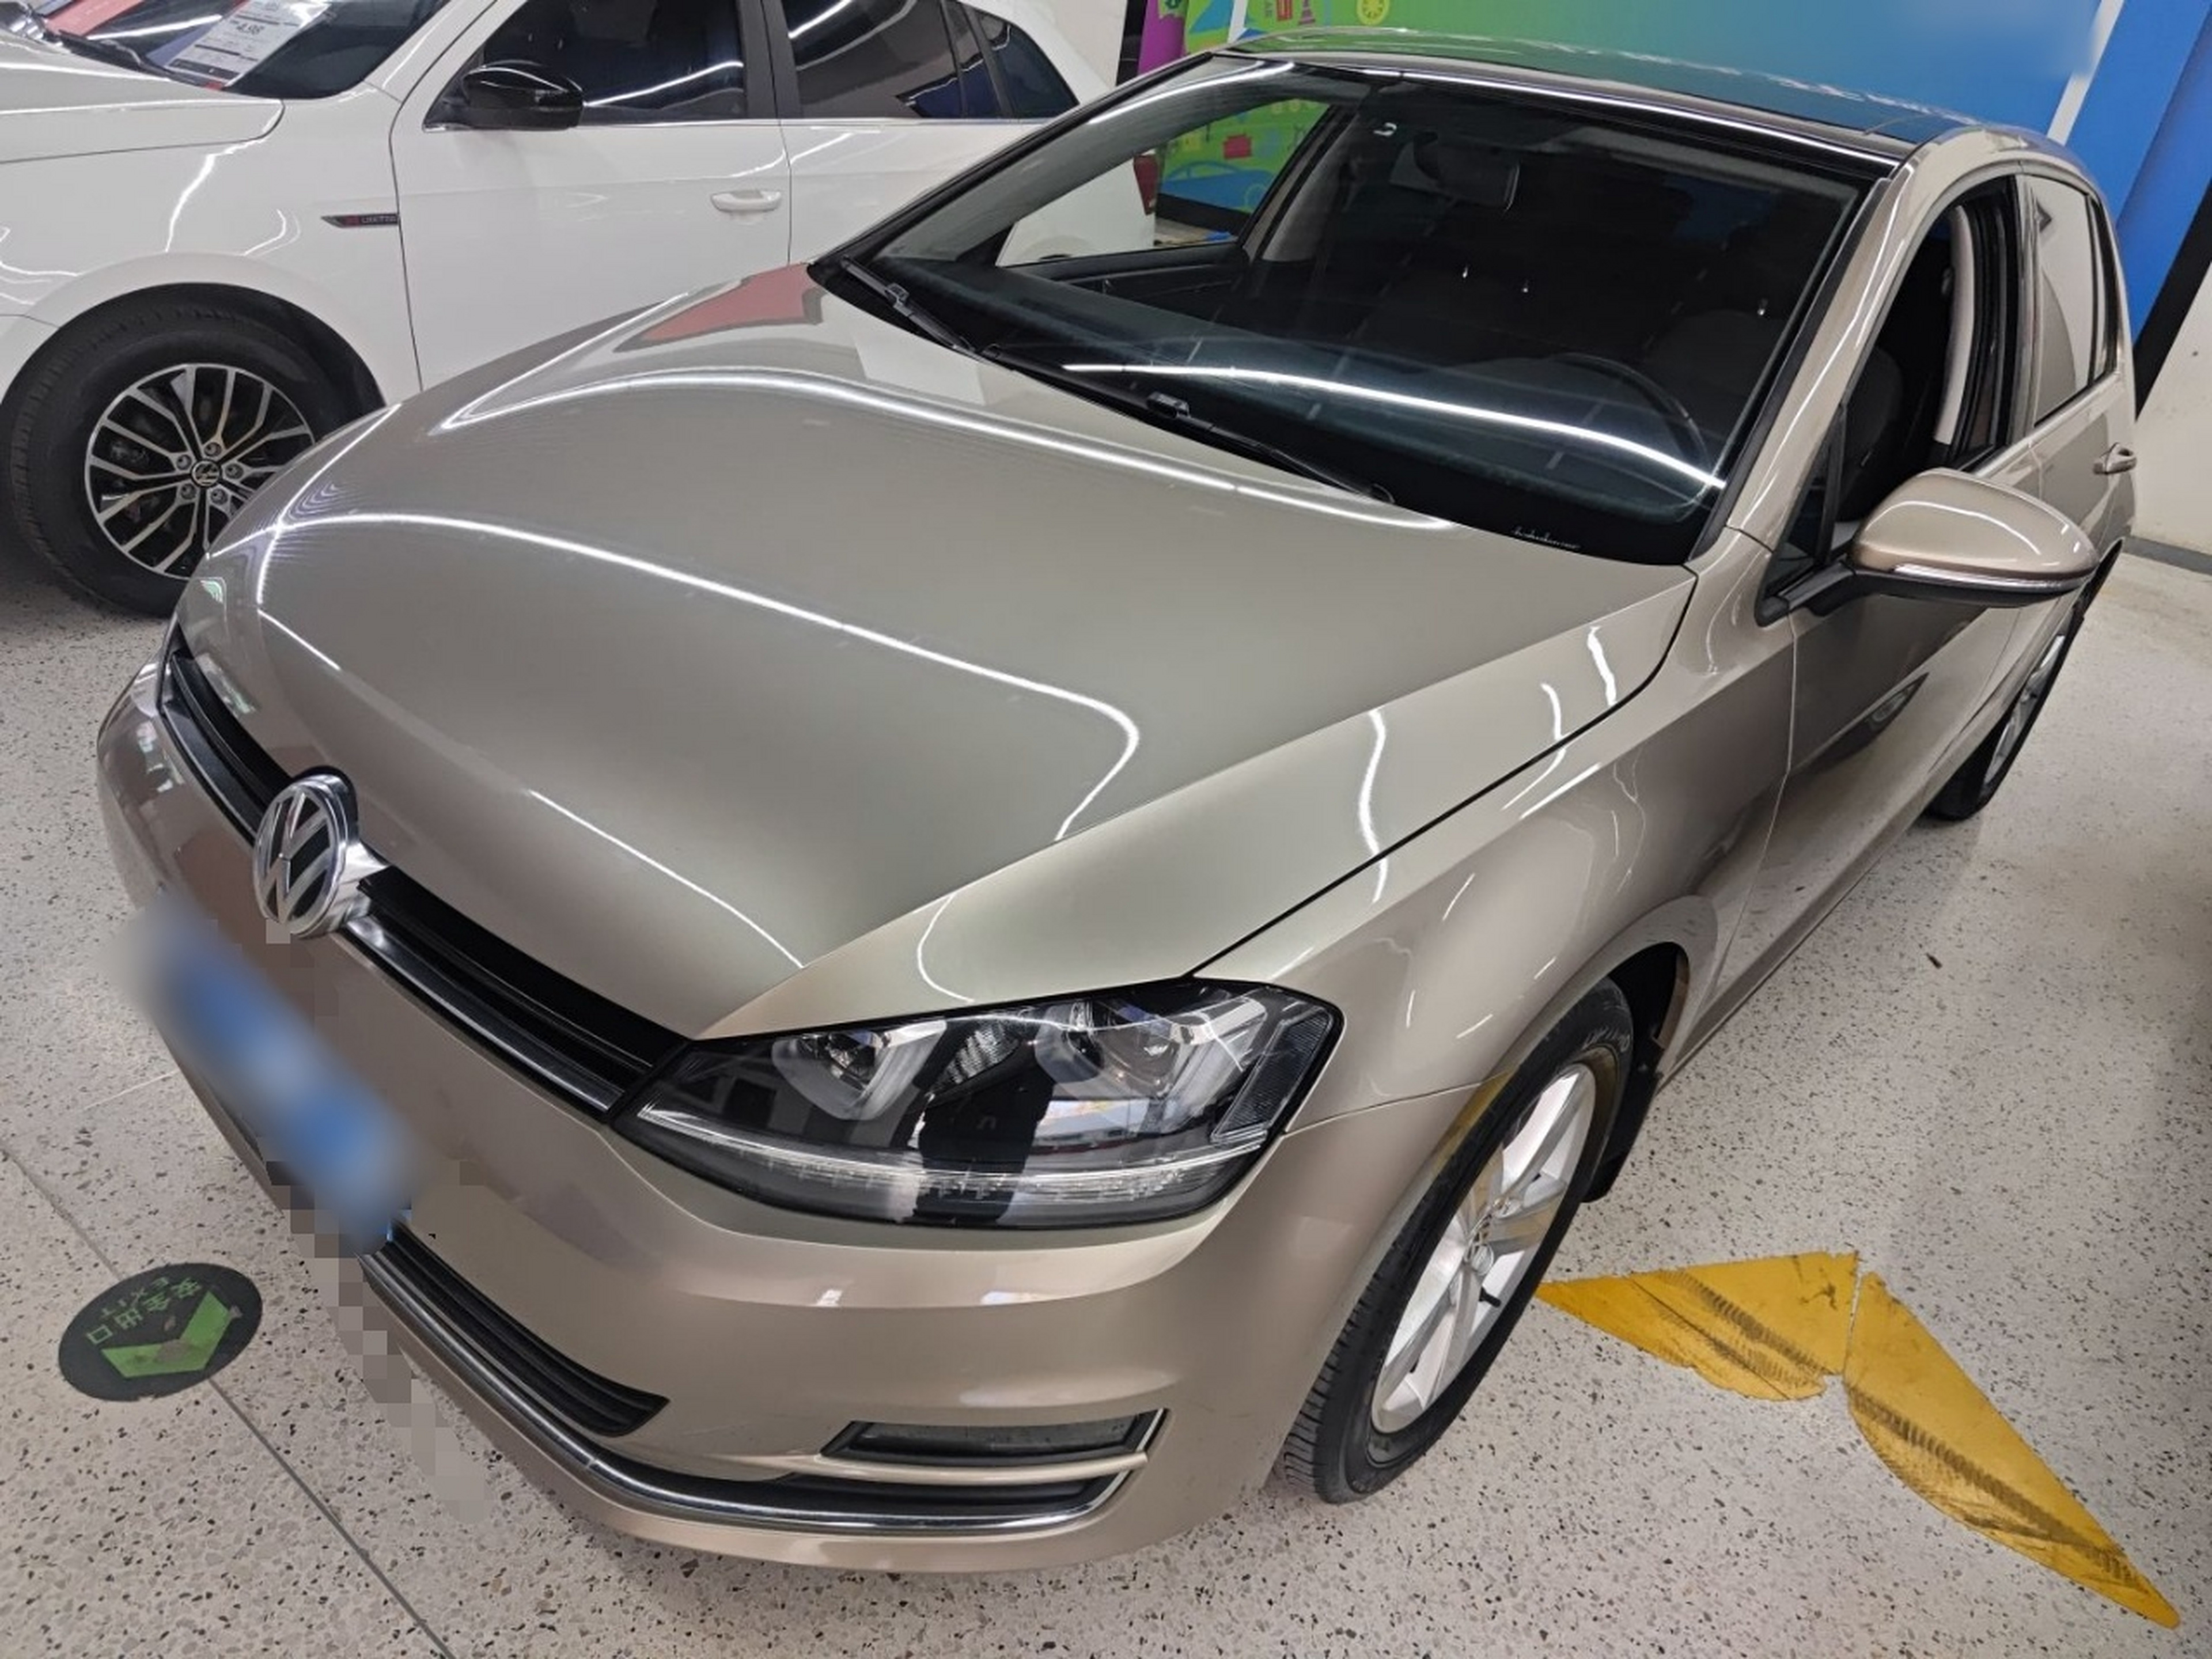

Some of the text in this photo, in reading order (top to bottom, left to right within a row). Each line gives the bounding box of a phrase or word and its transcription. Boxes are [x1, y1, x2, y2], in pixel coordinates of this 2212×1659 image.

[86, 1277, 201, 1345] 安全出口
[99, 1277, 169, 1320] EXIT
